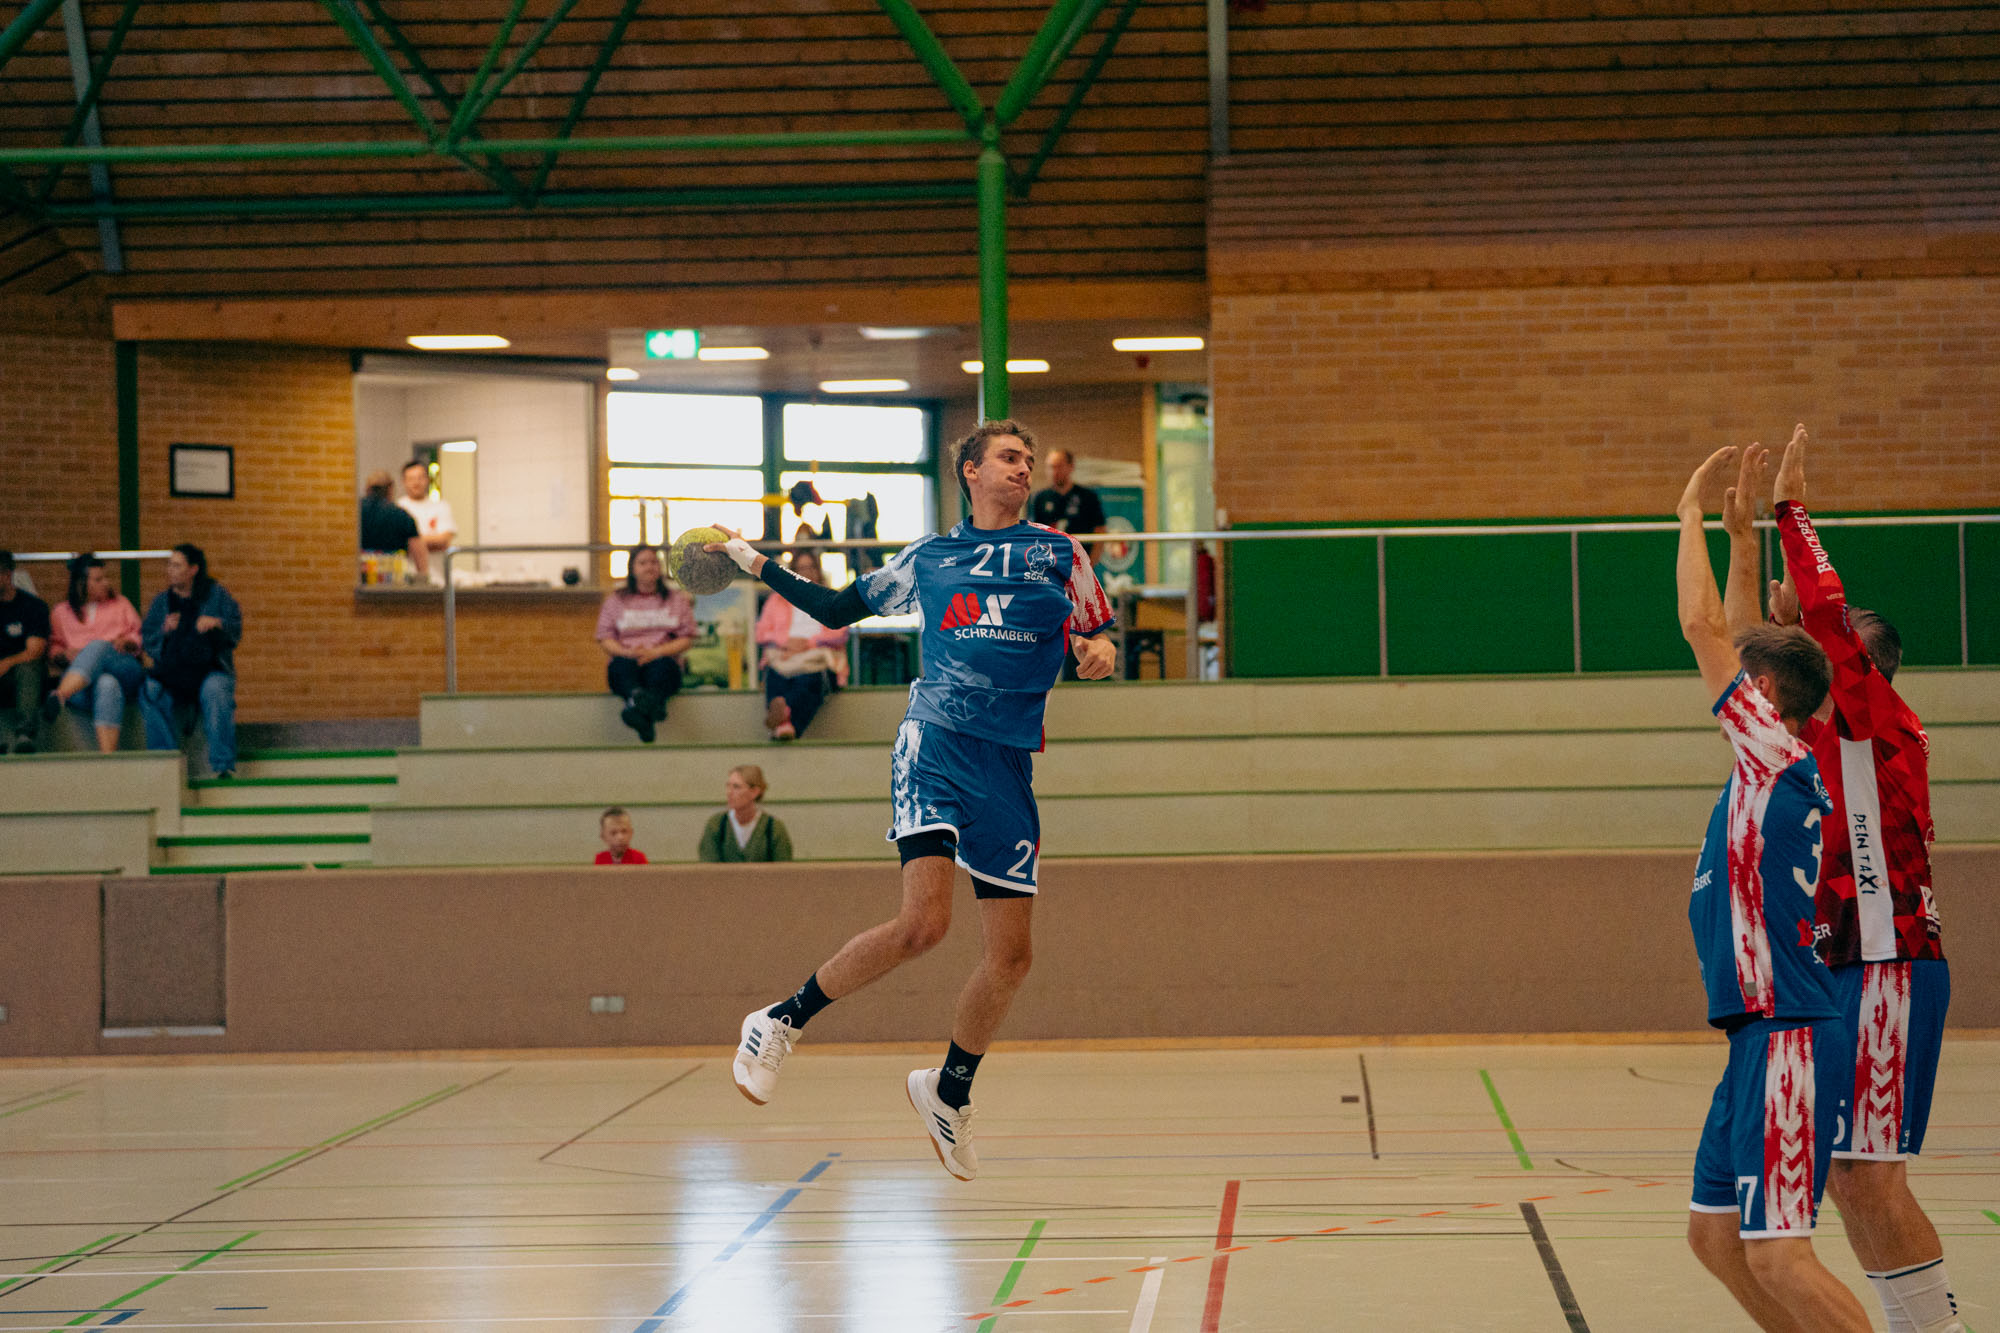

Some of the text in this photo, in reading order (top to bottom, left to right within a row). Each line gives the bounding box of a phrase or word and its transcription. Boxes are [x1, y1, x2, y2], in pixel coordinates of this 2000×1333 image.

[970, 543, 1012, 578] 21
[954, 627, 1038, 643] SCHRAMBERG
[1735, 1175, 1759, 1225] 7
